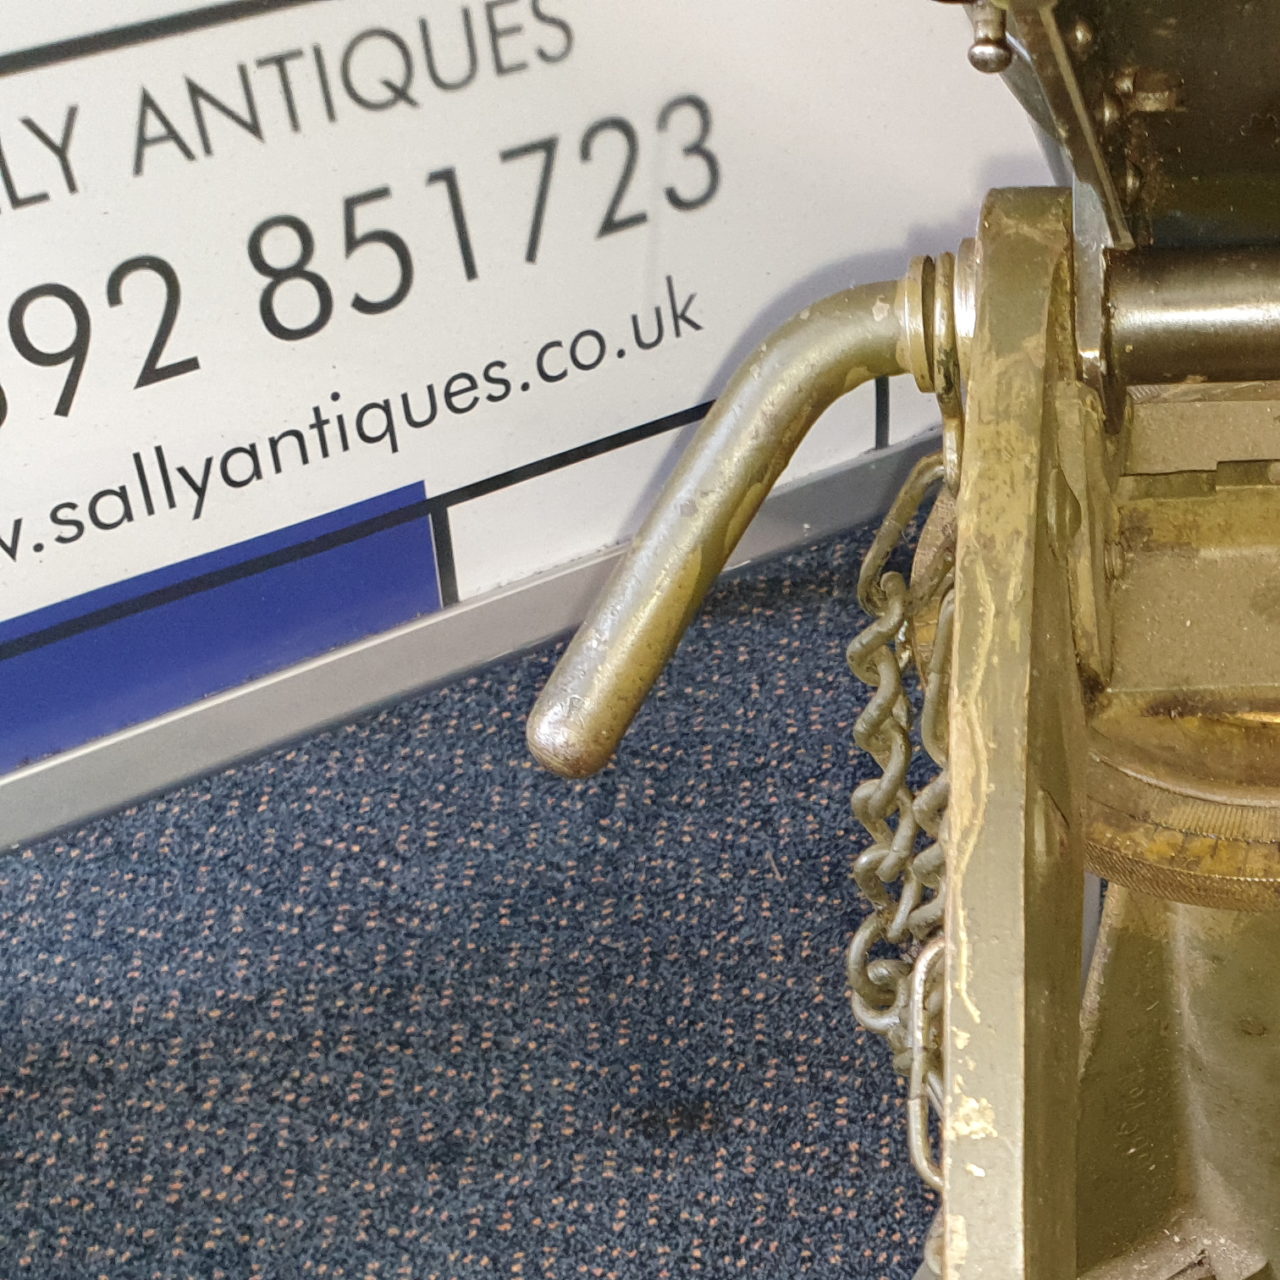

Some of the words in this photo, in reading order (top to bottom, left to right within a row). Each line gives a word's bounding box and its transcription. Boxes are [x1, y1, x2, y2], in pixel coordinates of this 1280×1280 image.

[0, 105, 78, 210] LY
[133, 0, 574, 176] ANTIQUES
[0, 255, 200, 428] 92
[247, 94, 720, 341] 851723
